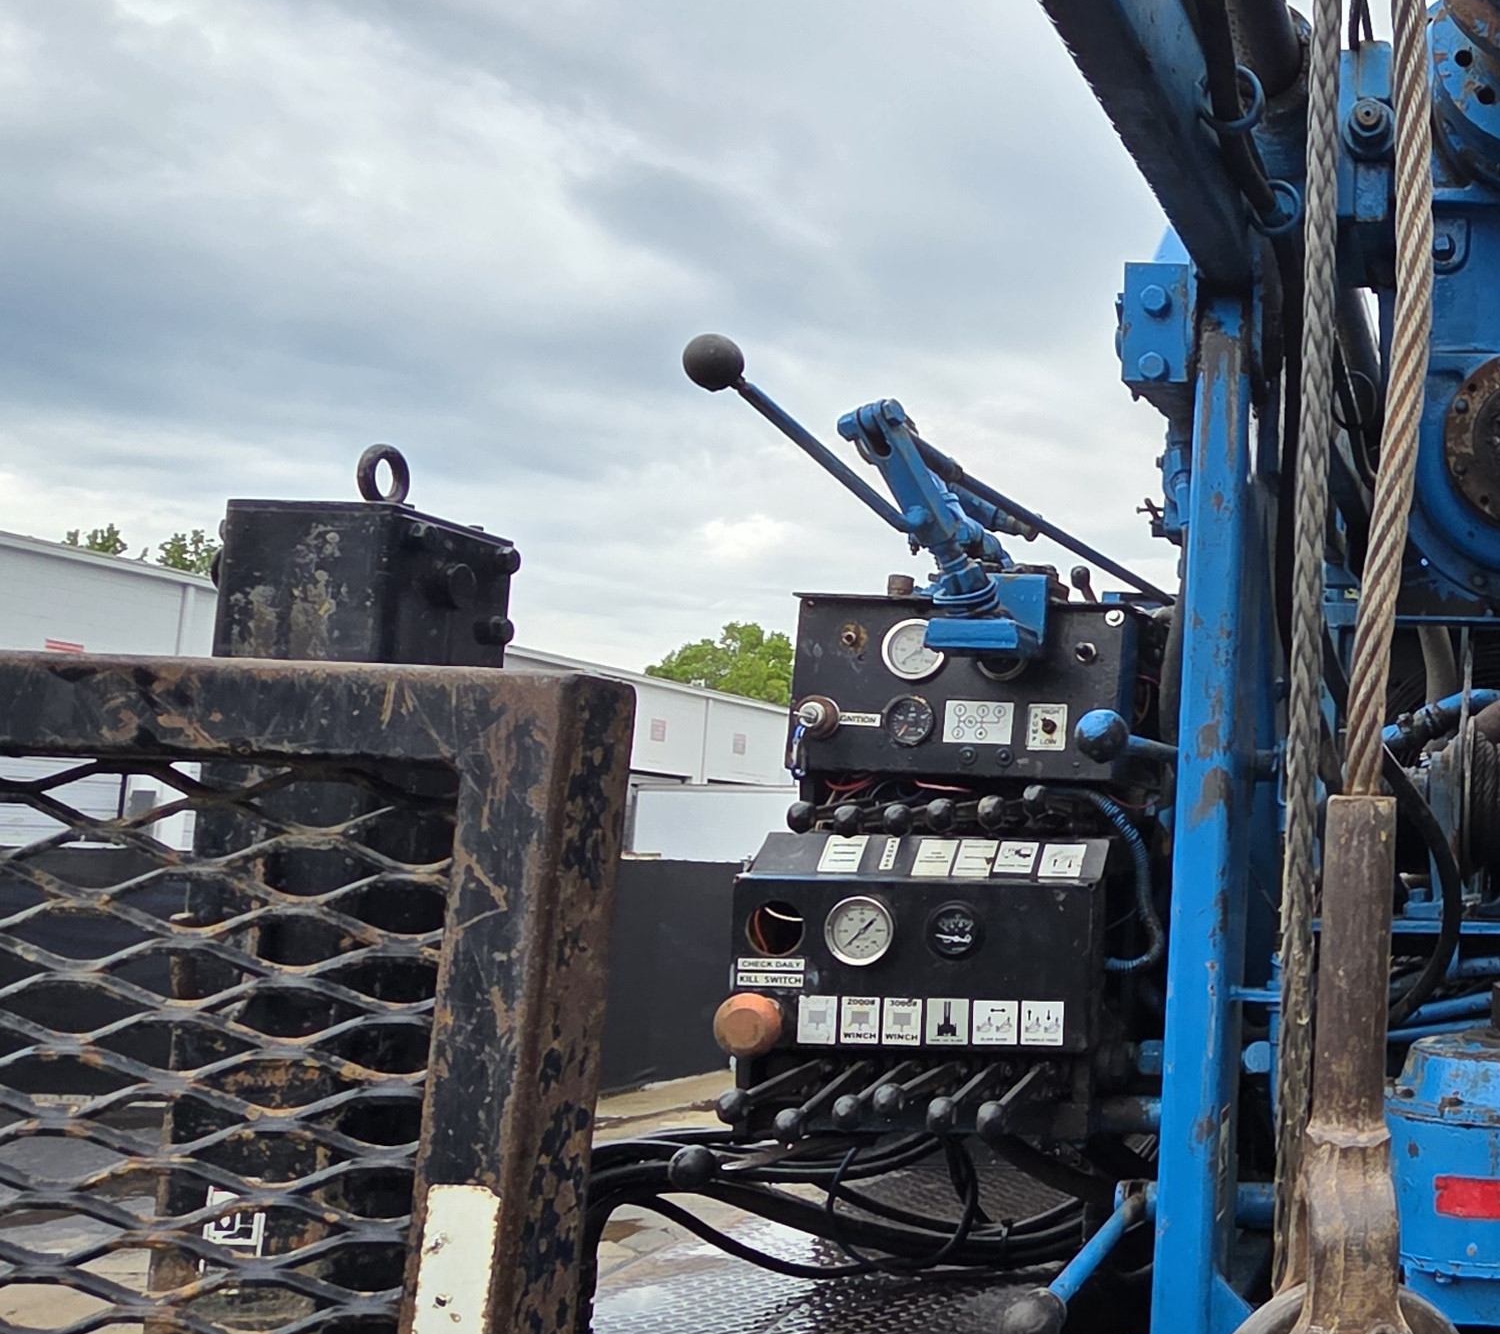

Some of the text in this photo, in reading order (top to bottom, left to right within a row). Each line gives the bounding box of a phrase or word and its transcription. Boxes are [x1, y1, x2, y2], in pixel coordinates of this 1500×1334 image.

[839, 714, 877, 724] GNITION
[741, 960, 801, 969] CHECK DAILY
[739, 975, 802, 985] KILL SWITCH
[843, 1032, 877, 1040] WINCH
[885, 1033, 919, 1041] WINCH
